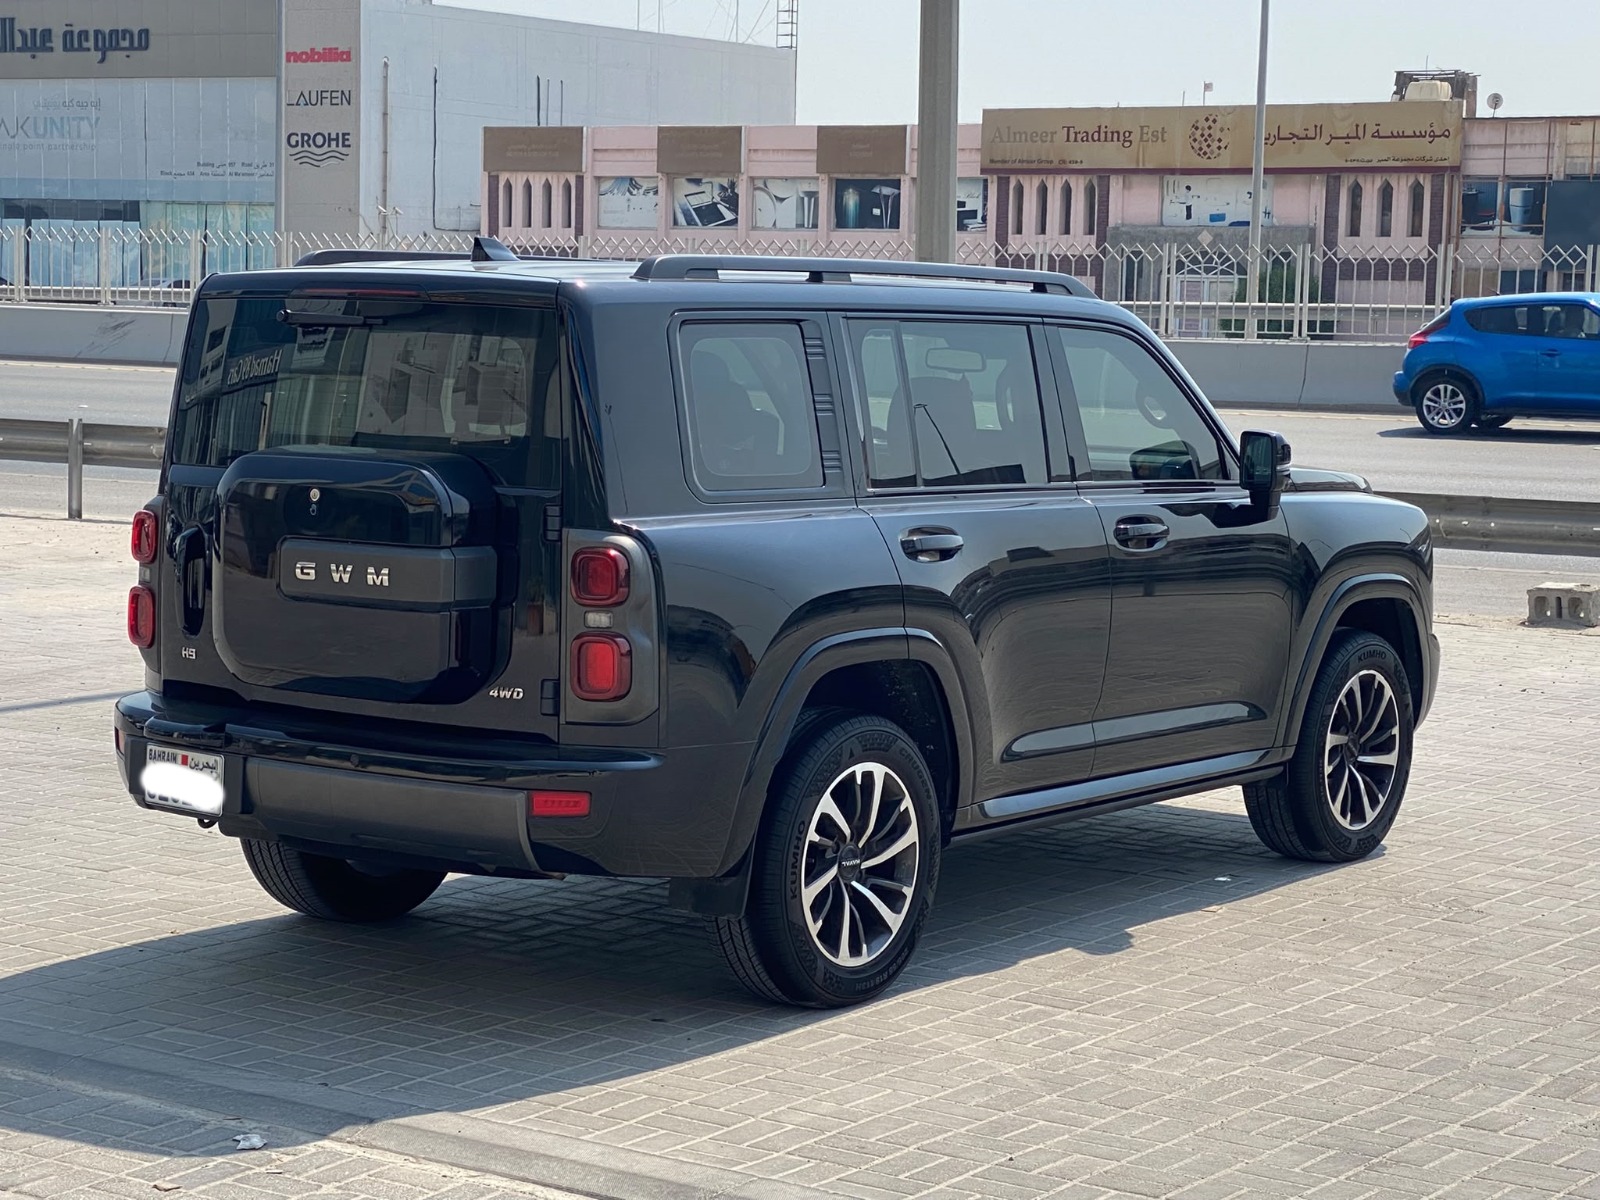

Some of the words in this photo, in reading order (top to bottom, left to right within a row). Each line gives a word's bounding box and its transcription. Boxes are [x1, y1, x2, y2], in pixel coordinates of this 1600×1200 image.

[62, 23, 150, 64] مجموعة
[285, 47, 352, 63] nobilia
[286, 90, 352, 106] LAUFEN
[286, 132, 352, 149] GROHE
[990, 126, 1058, 144] Almeer
[1062, 125, 1133, 149] Trading
[1138, 125, 1167, 143] Est
[1264, 124, 1323, 147] التجاري
[1371, 122, 1451, 144] مؤسسة
[295, 561, 390, 586] GWM
[181, 646, 196, 660] H9
[1357, 649, 1387, 664] KUMHO
[488, 686, 524, 700] 4WD
[148, 748, 178, 764] BAHRAIN
[790, 820, 806, 900] KUMHO
